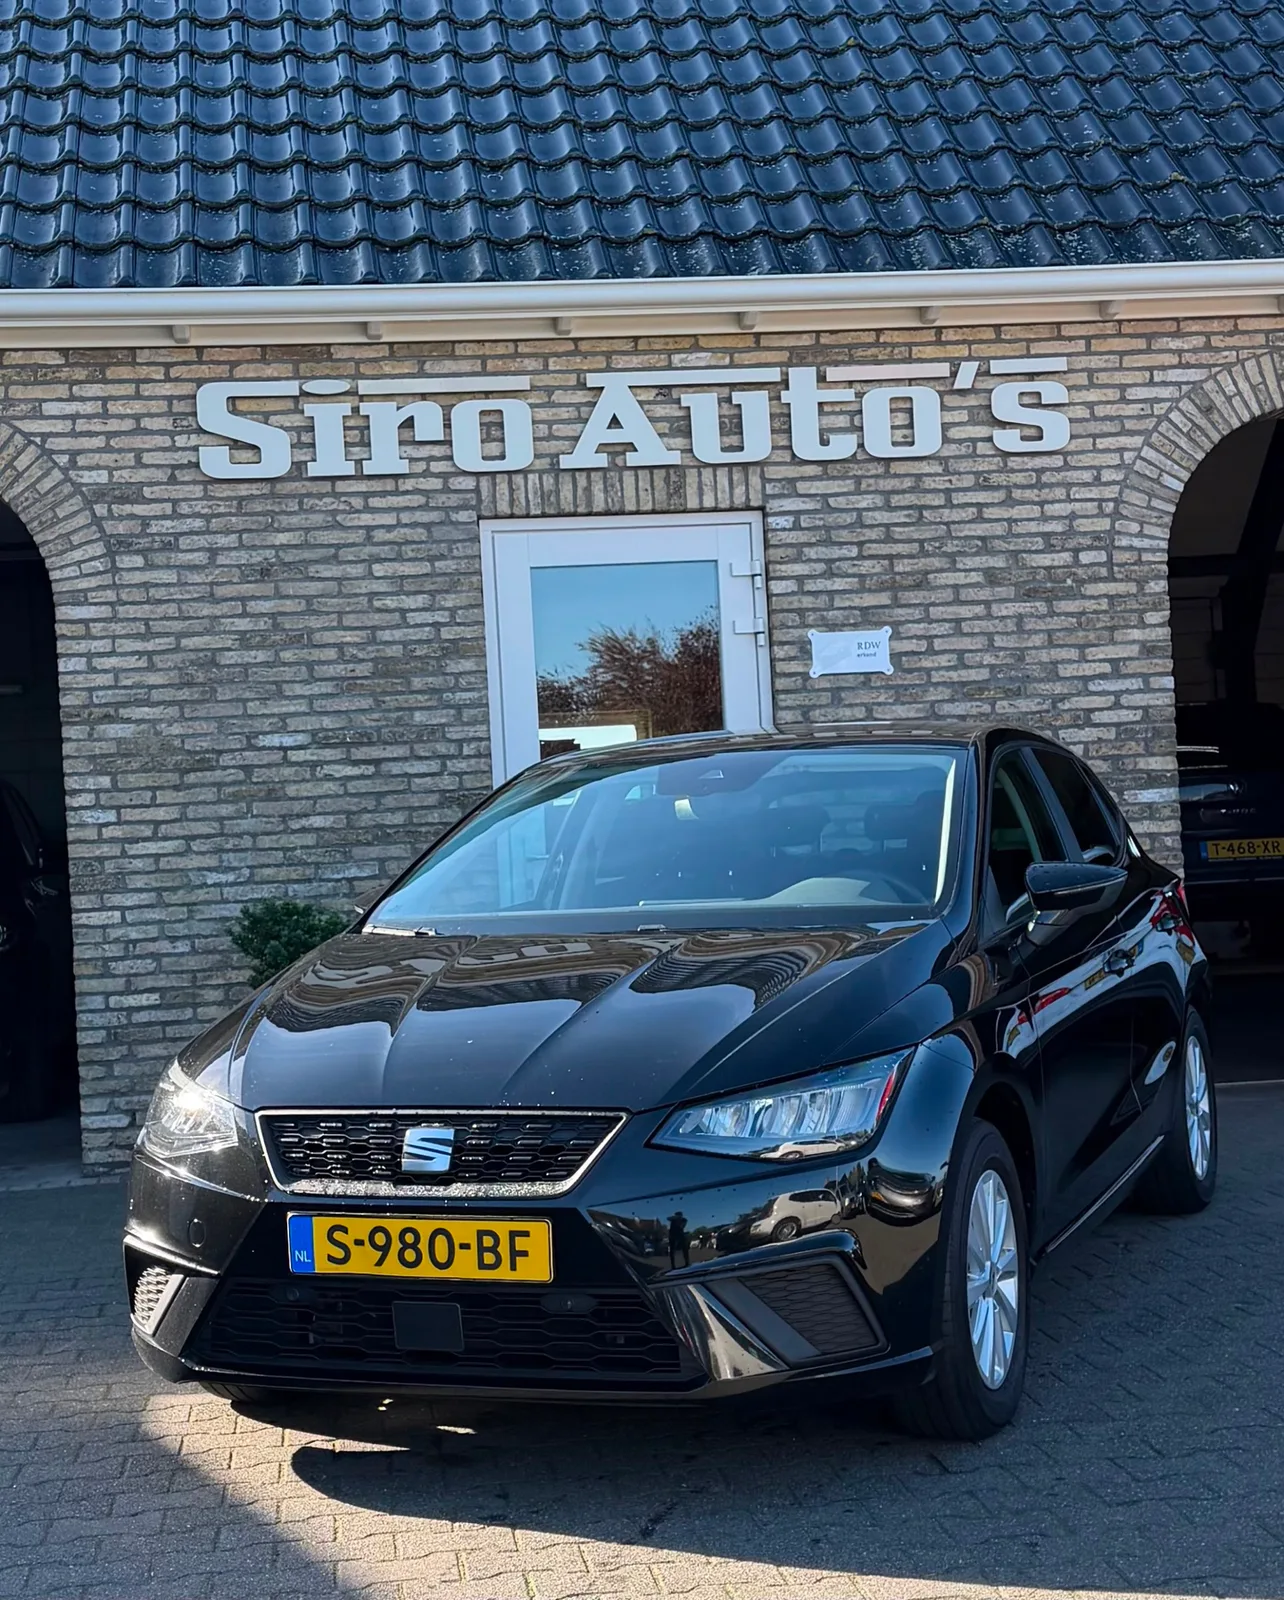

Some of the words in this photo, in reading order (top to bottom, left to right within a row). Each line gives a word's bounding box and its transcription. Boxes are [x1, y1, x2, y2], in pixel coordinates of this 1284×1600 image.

[196, 376, 536, 479] Siro
[559, 357, 1071, 470] Auto's
[857, 641, 881, 650] RDW
[1211, 841, 1281, 856] T-468-XR
[326, 1223, 531, 1272] S-980-BF
[294, 1249, 312, 1263] NL
